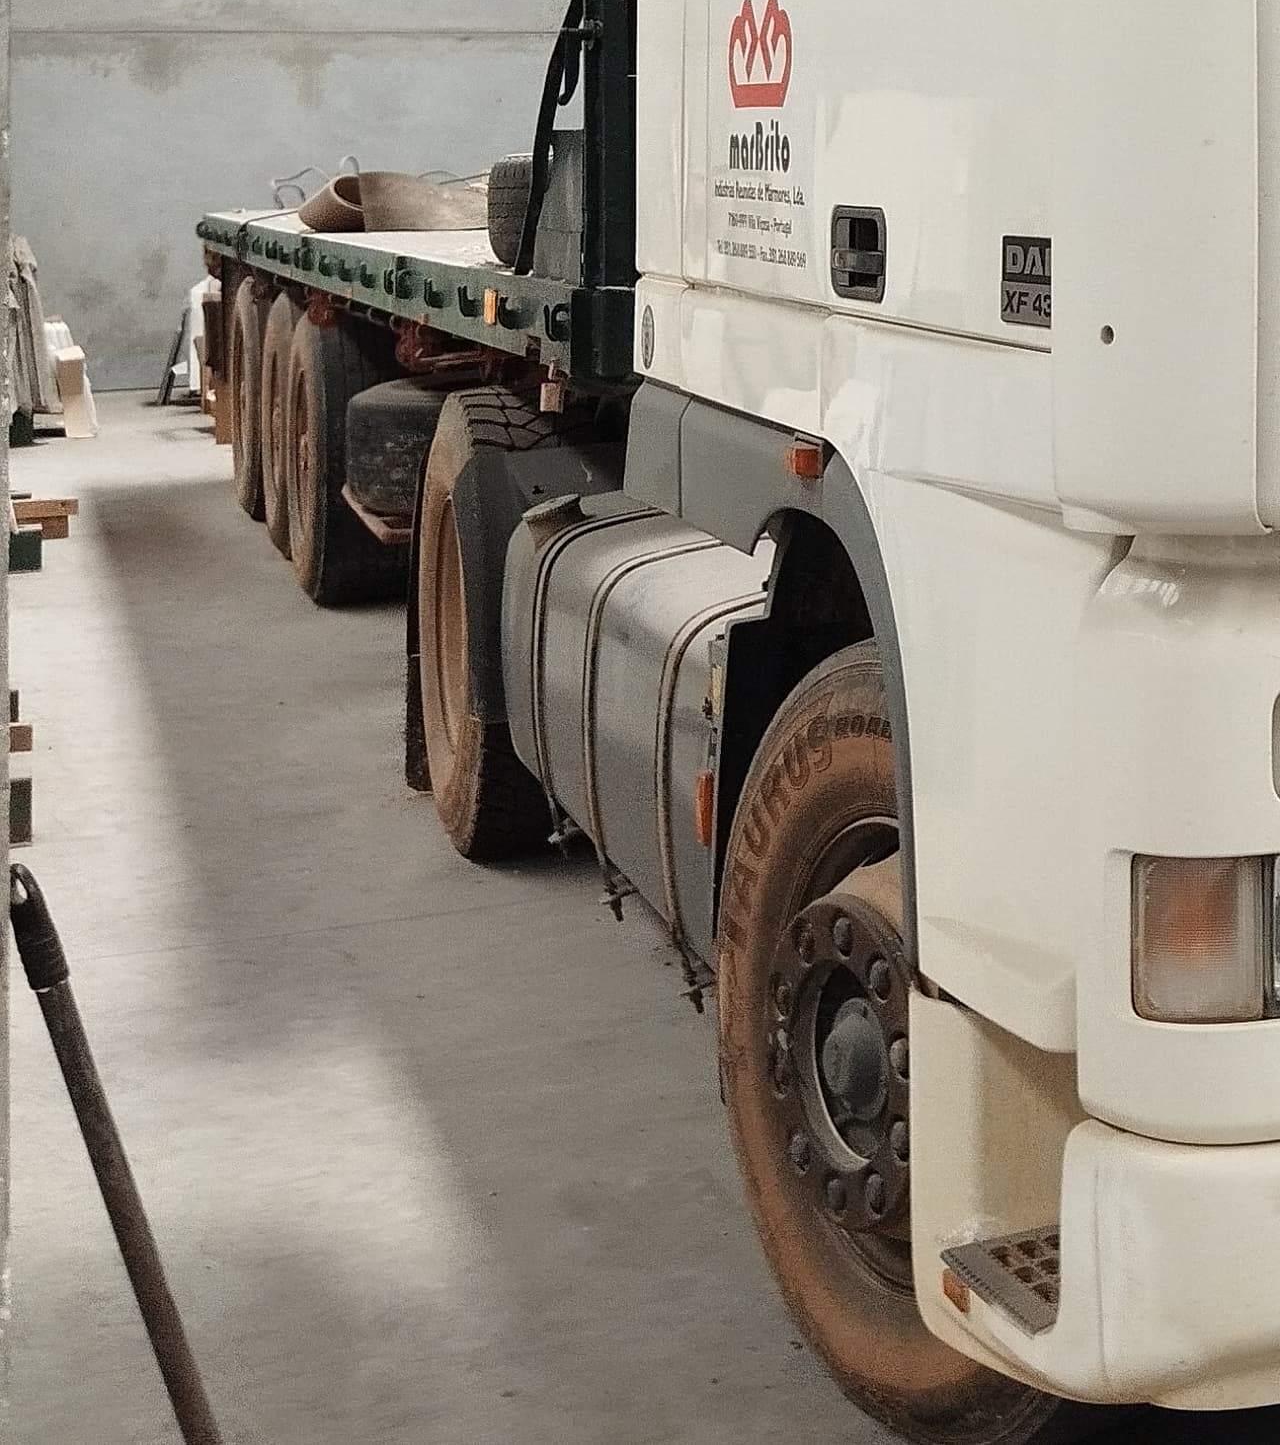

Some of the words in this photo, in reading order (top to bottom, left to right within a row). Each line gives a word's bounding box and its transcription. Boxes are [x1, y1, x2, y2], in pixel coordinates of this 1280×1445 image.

[729, 119, 790, 173] marBrito
[1006, 244, 1050, 276] DA
[1001, 290, 1029, 314] XF
[1032, 293, 1050, 317] 43
